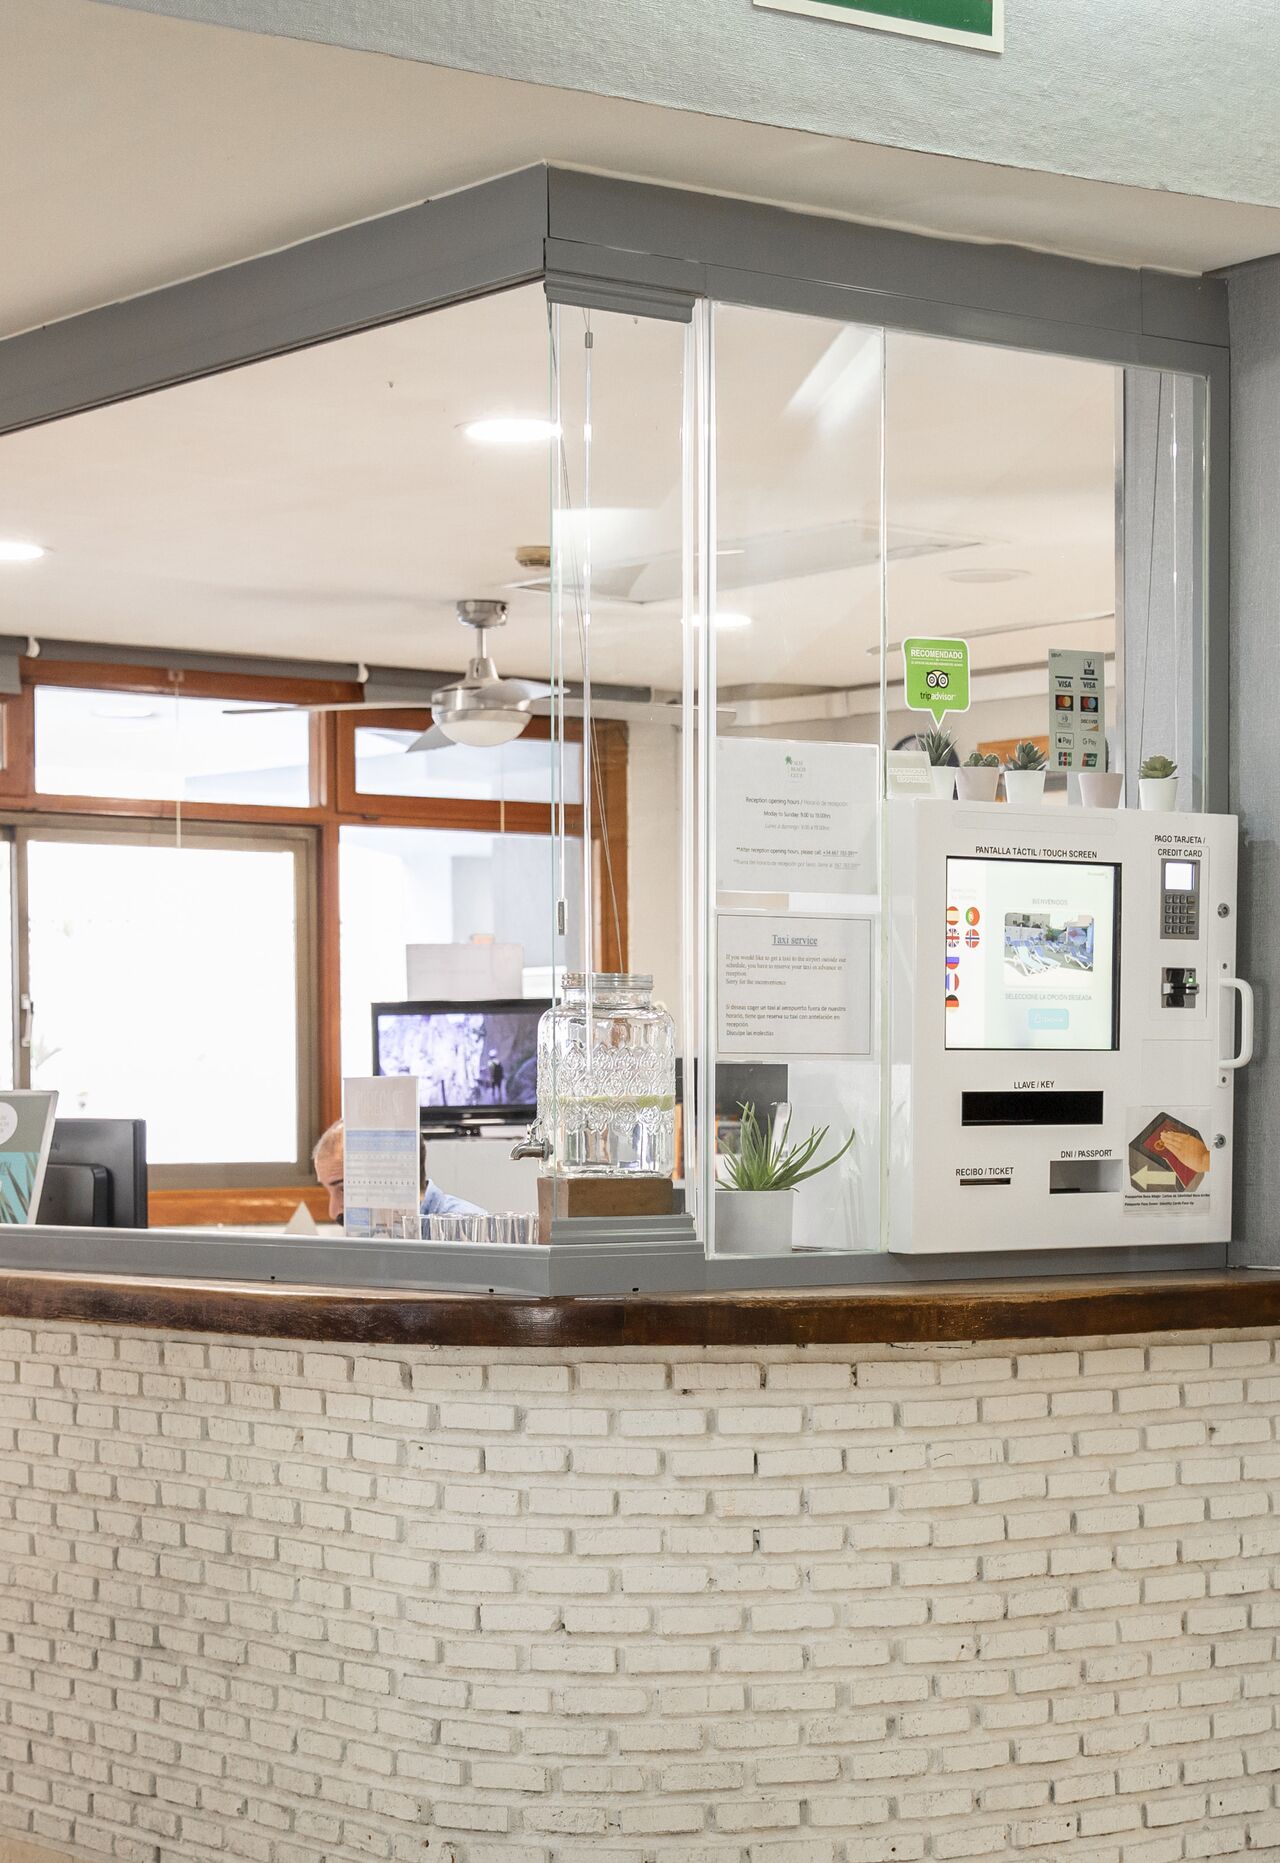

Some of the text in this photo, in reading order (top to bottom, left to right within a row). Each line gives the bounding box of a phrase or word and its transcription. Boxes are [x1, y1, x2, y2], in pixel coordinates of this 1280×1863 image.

[910, 649, 963, 659] RECOMENDADO
[1058, 680, 1072, 688] VISA
[1083, 681, 1096, 689] VISA
[920, 691, 954, 701] tripadvisor
[1063, 736, 1072, 746] Pay
[1154, 835, 1172, 844] PAGO
[1174, 836, 1202, 844] TARJETA
[975, 846, 1012, 855] PANTALLA
[1043, 849, 1068, 858] TOUCH
[1069, 850, 1098, 859] SCREEN
[1158, 848, 1202, 858] CREDIT CARD
[772, 934, 818, 946] Taxi service
[1040, 1080, 1055, 1088] KEY
[1060, 1150, 1074, 1158] DNI
[1078, 1150, 1112, 1158] PASSPORT
[956, 1168, 983, 1177] RECIBO
[988, 1167, 1014, 1176] TICKET
